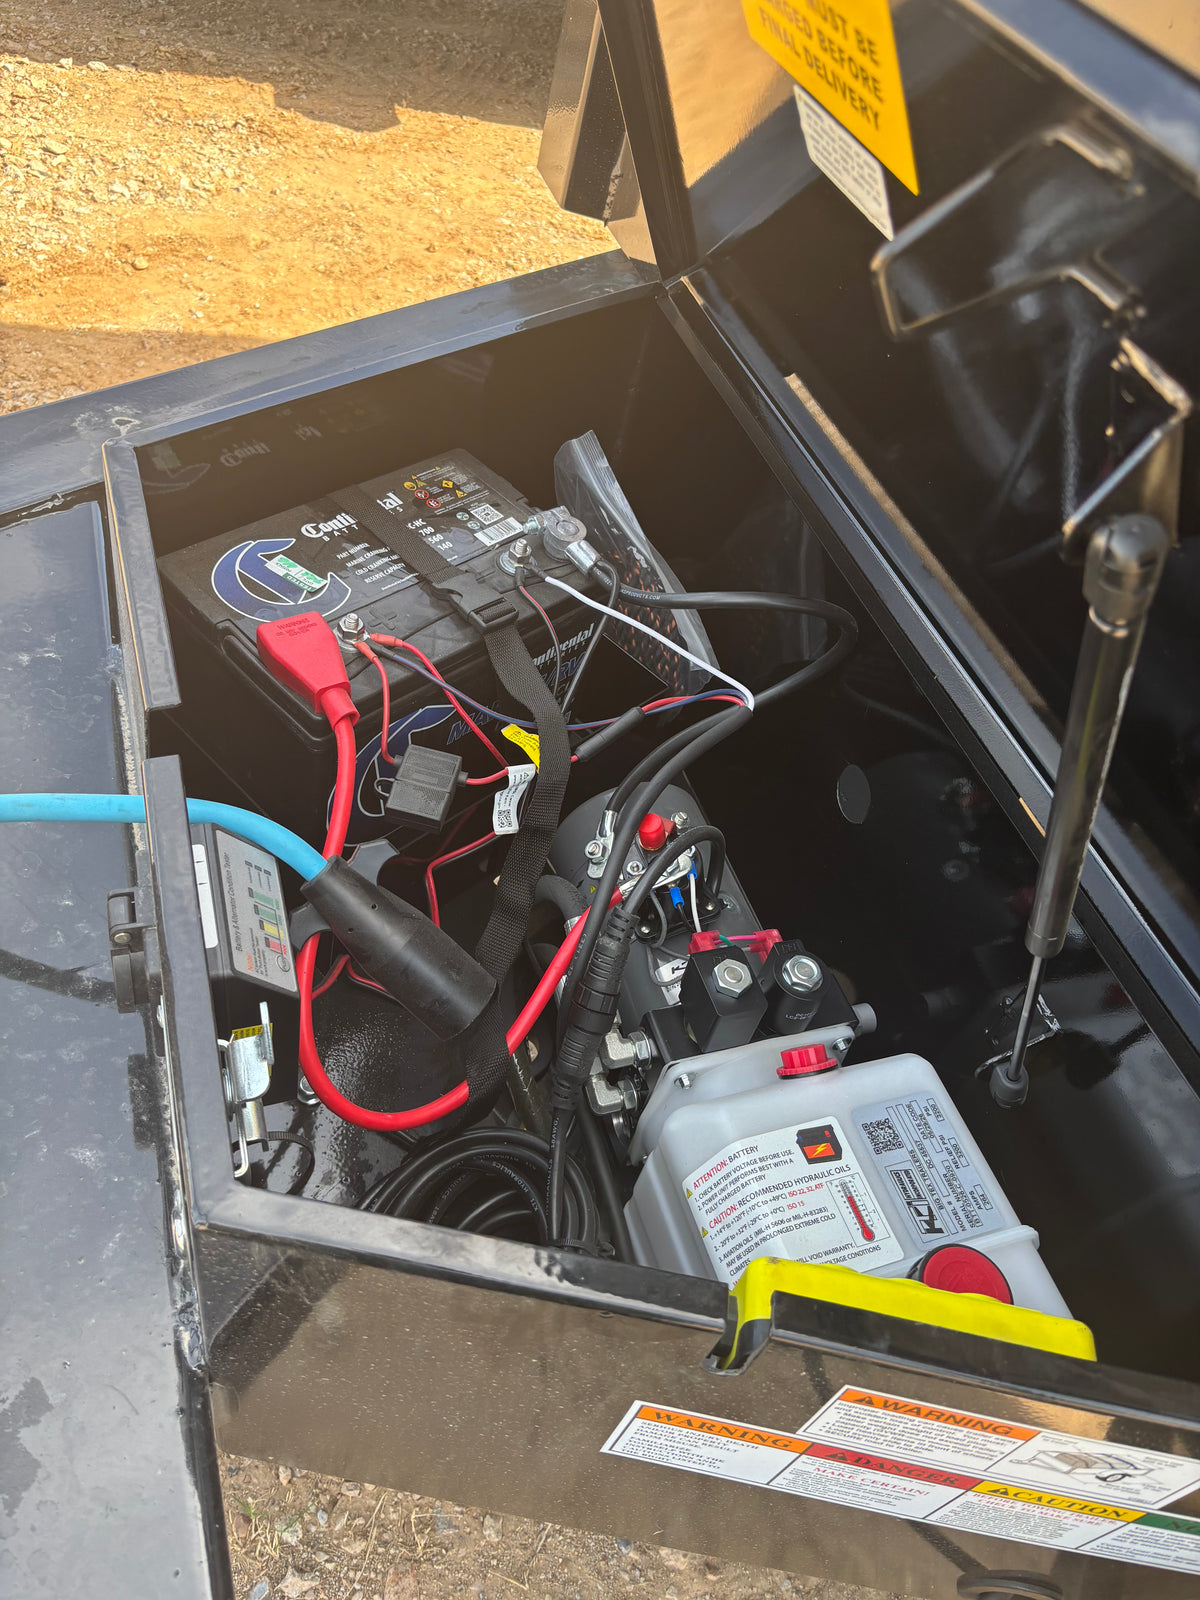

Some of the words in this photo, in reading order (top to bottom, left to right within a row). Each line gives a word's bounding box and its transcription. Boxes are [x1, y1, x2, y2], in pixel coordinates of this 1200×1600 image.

[854, 28, 880, 67] BE
[759, 6, 801, 60] FINAL
[802, 44, 879, 132] DELIVERY
[816, 28, 884, 104] BEFORE
[418, 526, 435, 537] 700
[427, 533, 444, 544] 560
[336, 551, 351, 560] PART
[350, 542, 370, 556] NUMBER
[437, 541, 453, 551] 140
[355, 566, 368, 576] COLD
[905, 1103, 918, 1121] CODE
[922, 1105, 932, 1116] PSI
[930, 1103, 941, 1118] 3200
[915, 1123, 928, 1139] DATE
[938, 1134, 947, 1145] PSI
[915, 1139, 928, 1158] 45537
[944, 1146, 961, 1169] RELIEF
[691, 1158, 729, 1190] ATTENTION:
[727, 1144, 759, 1163] BATTERY
[697, 1184, 713, 1200] CHECK
[712, 1169, 733, 1188] BATTERY
[731, 1157, 758, 1173] VOLTAGE
[758, 1151, 781, 1162] BEFORE
[908, 1148, 929, 1181] TRAILERS
[925, 1158, 934, 1168] DC
[492, 1161, 529, 1193] HYDRAULICS
[700, 1191, 718, 1208] POWER
[716, 1183, 729, 1196] UNIT
[728, 1166, 758, 1187] PERFORMS
[758, 1162, 773, 1171] BEST
[772, 1159, 788, 1168] WITH
[892, 1170, 911, 1198] HYDRAULICS
[903, 1169, 922, 1198] INCORPORATED
[926, 1183, 937, 1195] TEX
[942, 1172, 961, 1202] NUMBER
[704, 1201, 719, 1215] FULLY
[717, 1185, 741, 1205] CHARGED
[739, 1172, 767, 1189] BATTERY
[707, 1202, 738, 1229] CAUTION:
[737, 1180, 793, 1207] RECOMMENDED
[793, 1169, 834, 1185] HYDRAULIC
[834, 1164, 851, 1173] OILS
[787, 1189, 798, 1197] ISO
[934, 1197, 944, 1210] BIG
[968, 1190, 983, 1209] AMPS
[786, 1202, 797, 1210] ISO
[950, 1206, 967, 1231] MODEL
[959, 1203, 976, 1228] SERIAL
[722, 1241, 743, 1260] AVIATION
[741, 1234, 753, 1246] OILS
[771, 1218, 786, 1227] 5606
[725, 1256, 737, 1268] MAY
[735, 1252, 743, 1261] BE
[741, 1244, 755, 1257] USED
[758, 1224, 794, 1244] PROLONGED
[793, 1217, 820, 1229] EXTREME
[819, 1212, 836, 1222] COLD
[808, 1251, 823, 1261] VOID
[822, 1241, 855, 1257] WARRANTY.
[848, 1245, 881, 1262] CONDITIONS
[650, 1411, 793, 1448] WARNING
[878, 1399, 1015, 1435] WARNING
[812, 1467, 858, 1480] MAKE
[859, 1477, 931, 1496] CERTAIN!
[852, 1456, 961, 1485] DANGER
[1010, 1490, 1128, 1518] CAUTION
